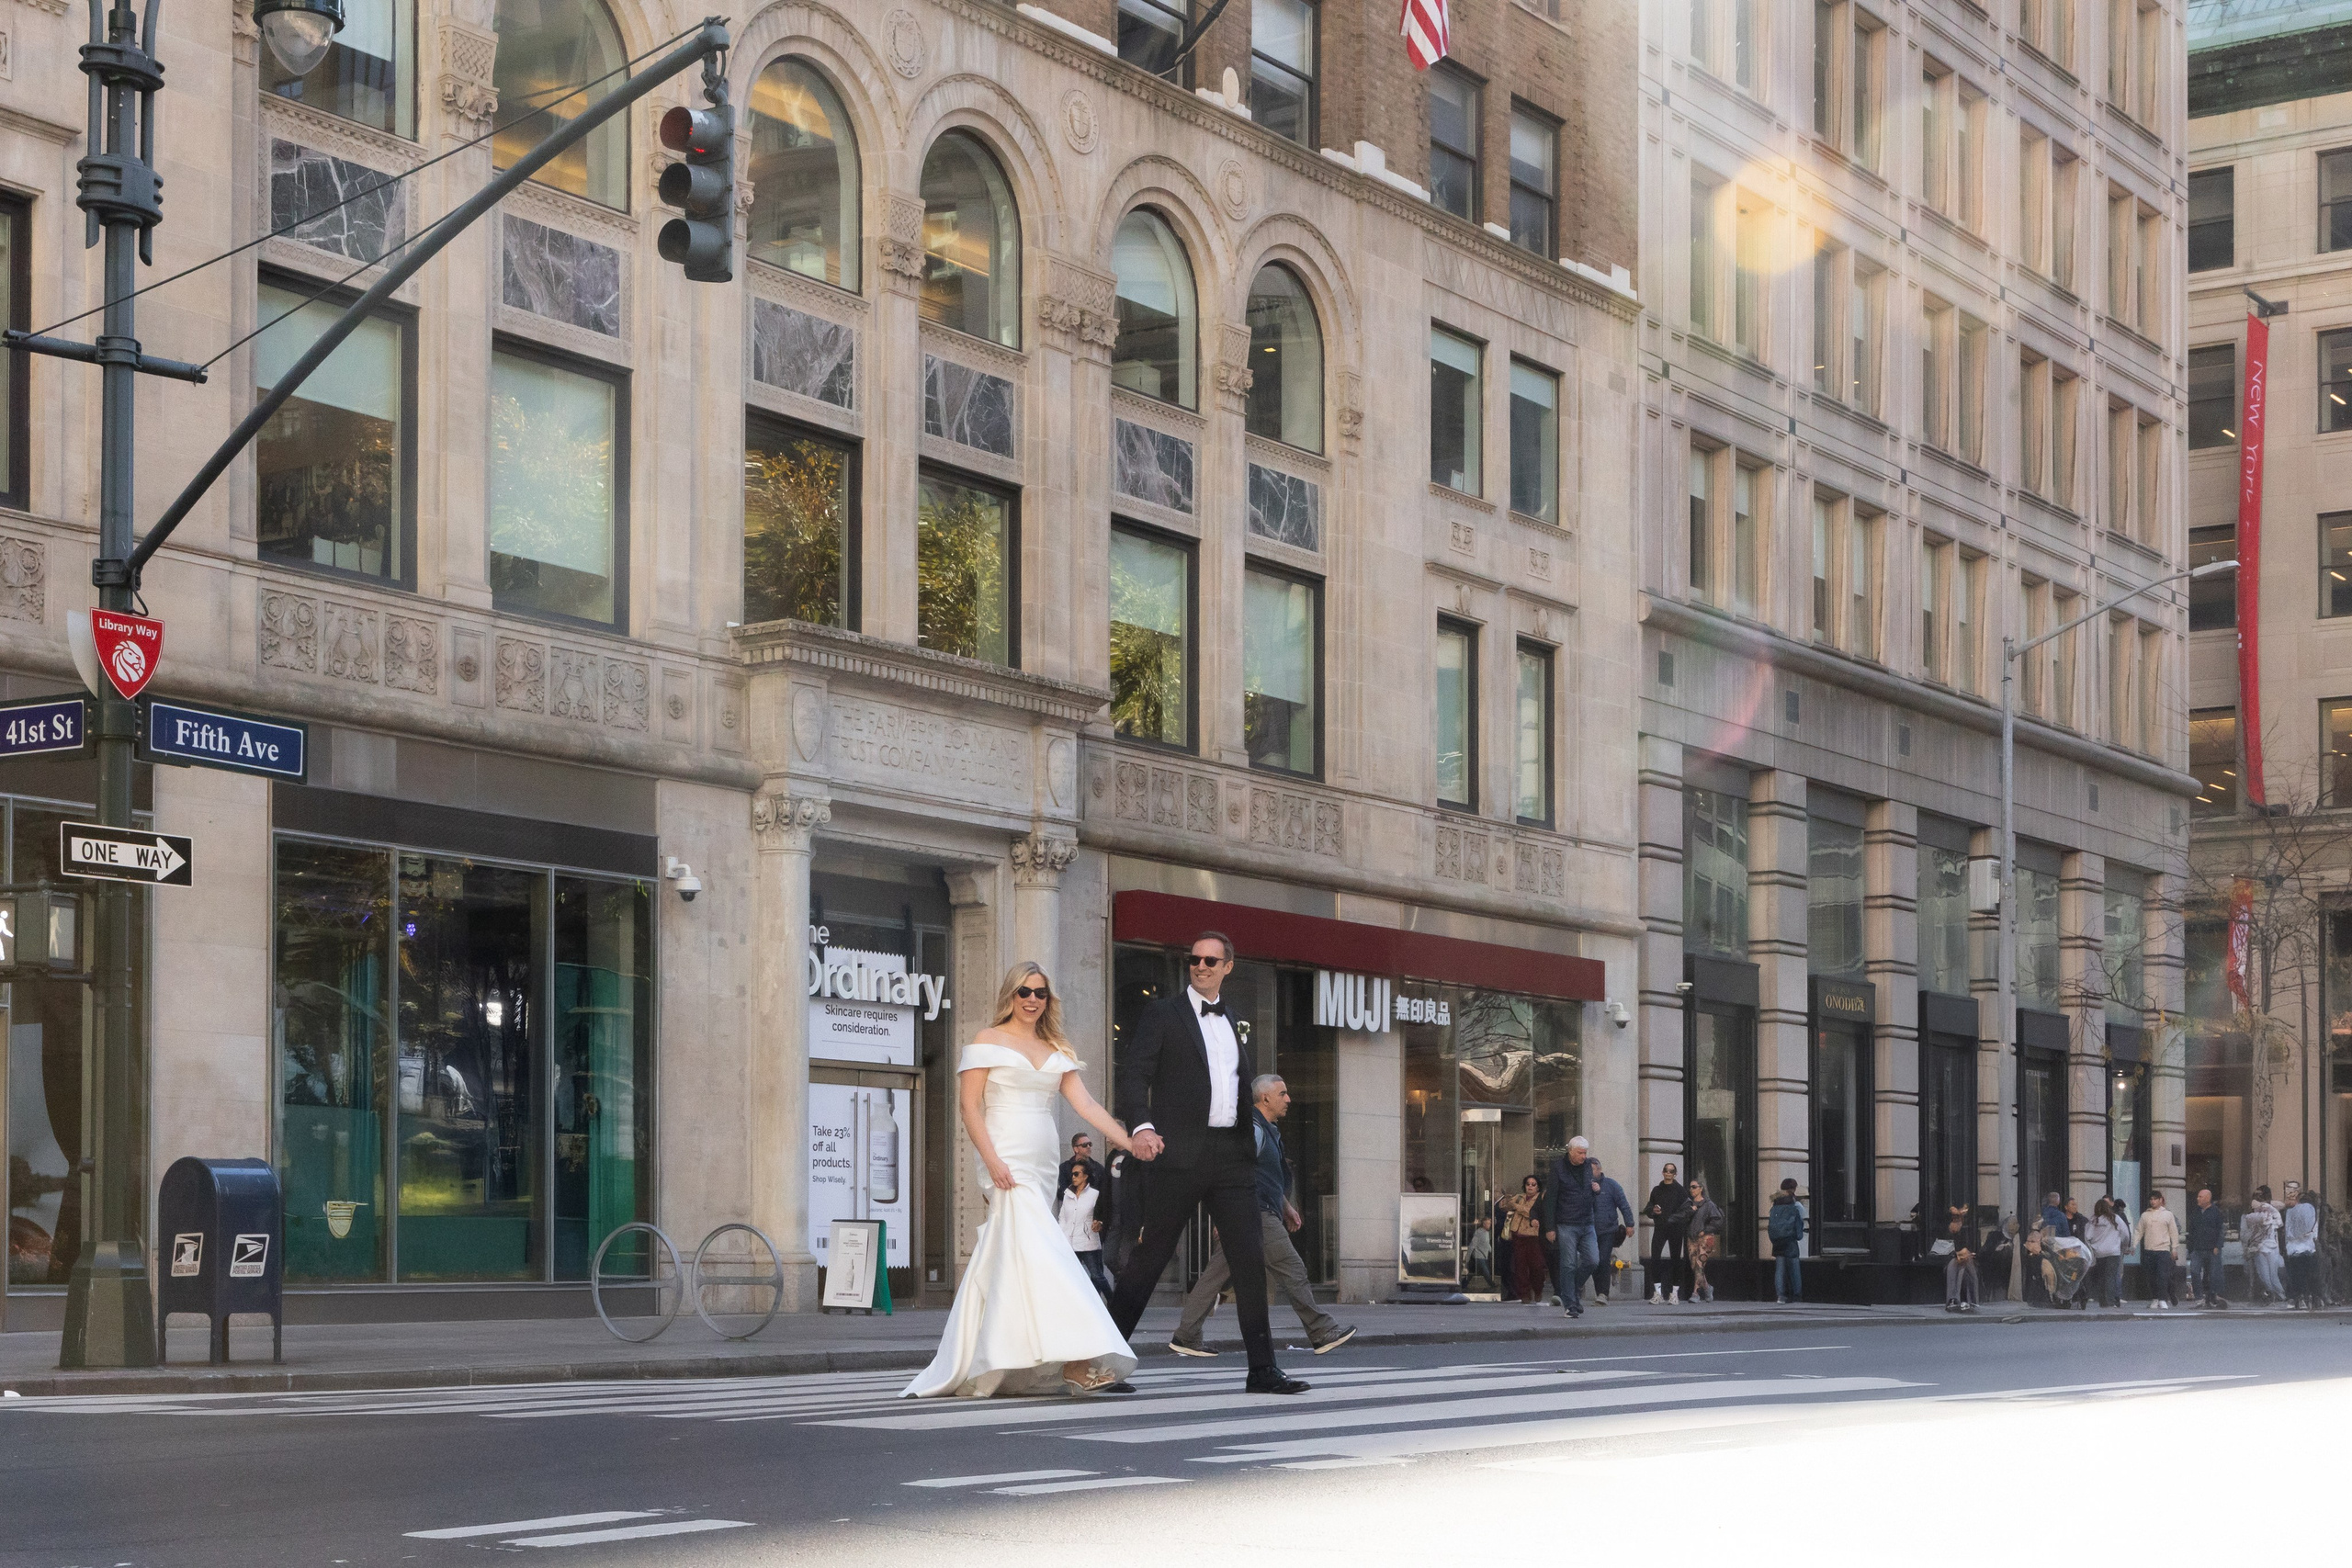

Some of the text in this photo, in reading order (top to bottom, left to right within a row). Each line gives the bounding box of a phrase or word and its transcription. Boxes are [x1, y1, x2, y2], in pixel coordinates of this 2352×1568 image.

[2248, 360, 2263, 428] New
[98, 617, 158, 641] Library Way
[6, 714, 74, 746] 41st St
[175, 718, 279, 761] Fifth Ave
[82, 840, 173, 869] ONE WAY
[1317, 970, 1390, 1032] MUJI
[1396, 994, 1451, 1026] 無印良品
[825, 1004, 898, 1023] Skincare requires
[831, 1021, 891, 1036] consideration.
[812, 1125, 851, 1139] Take 23%
[812, 1141, 836, 1153] off all
[812, 1156, 852, 1169] products.
[812, 1175, 827, 1184] Shop
